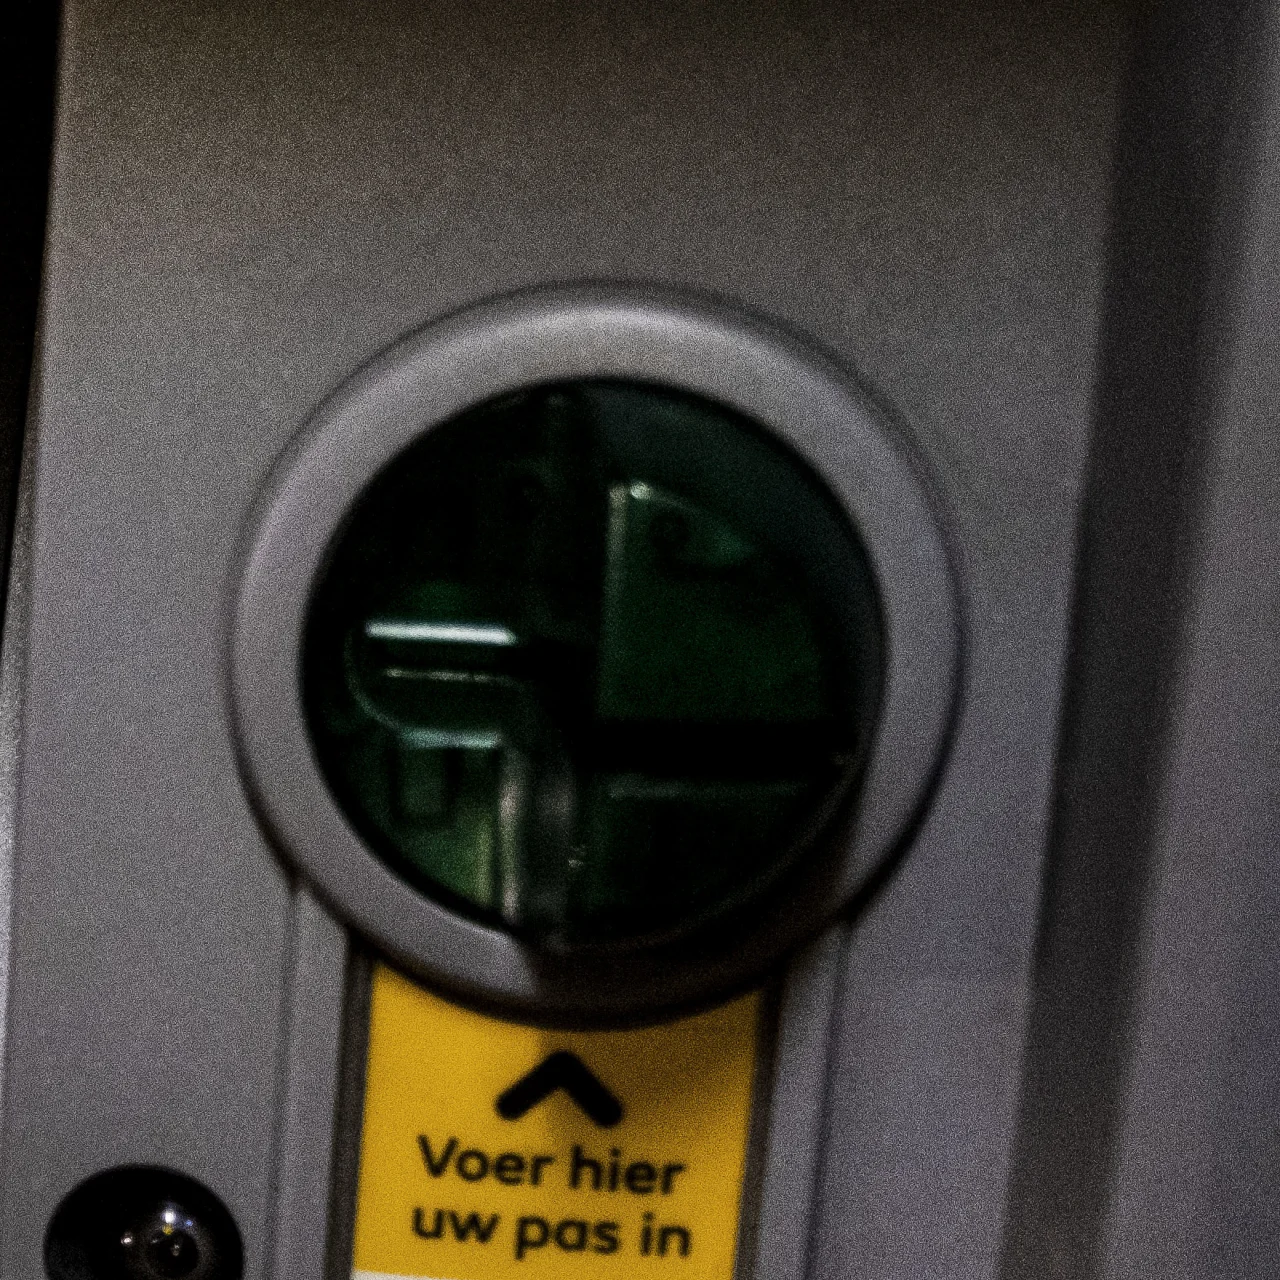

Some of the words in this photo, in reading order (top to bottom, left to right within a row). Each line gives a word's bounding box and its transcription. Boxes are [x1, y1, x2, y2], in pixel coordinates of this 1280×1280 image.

[416, 1134, 554, 1186] Voer
[568, 1144, 685, 1195] hier
[410, 1207, 499, 1243] uw
[514, 1214, 623, 1260] pas
[639, 1211, 694, 1259] in
